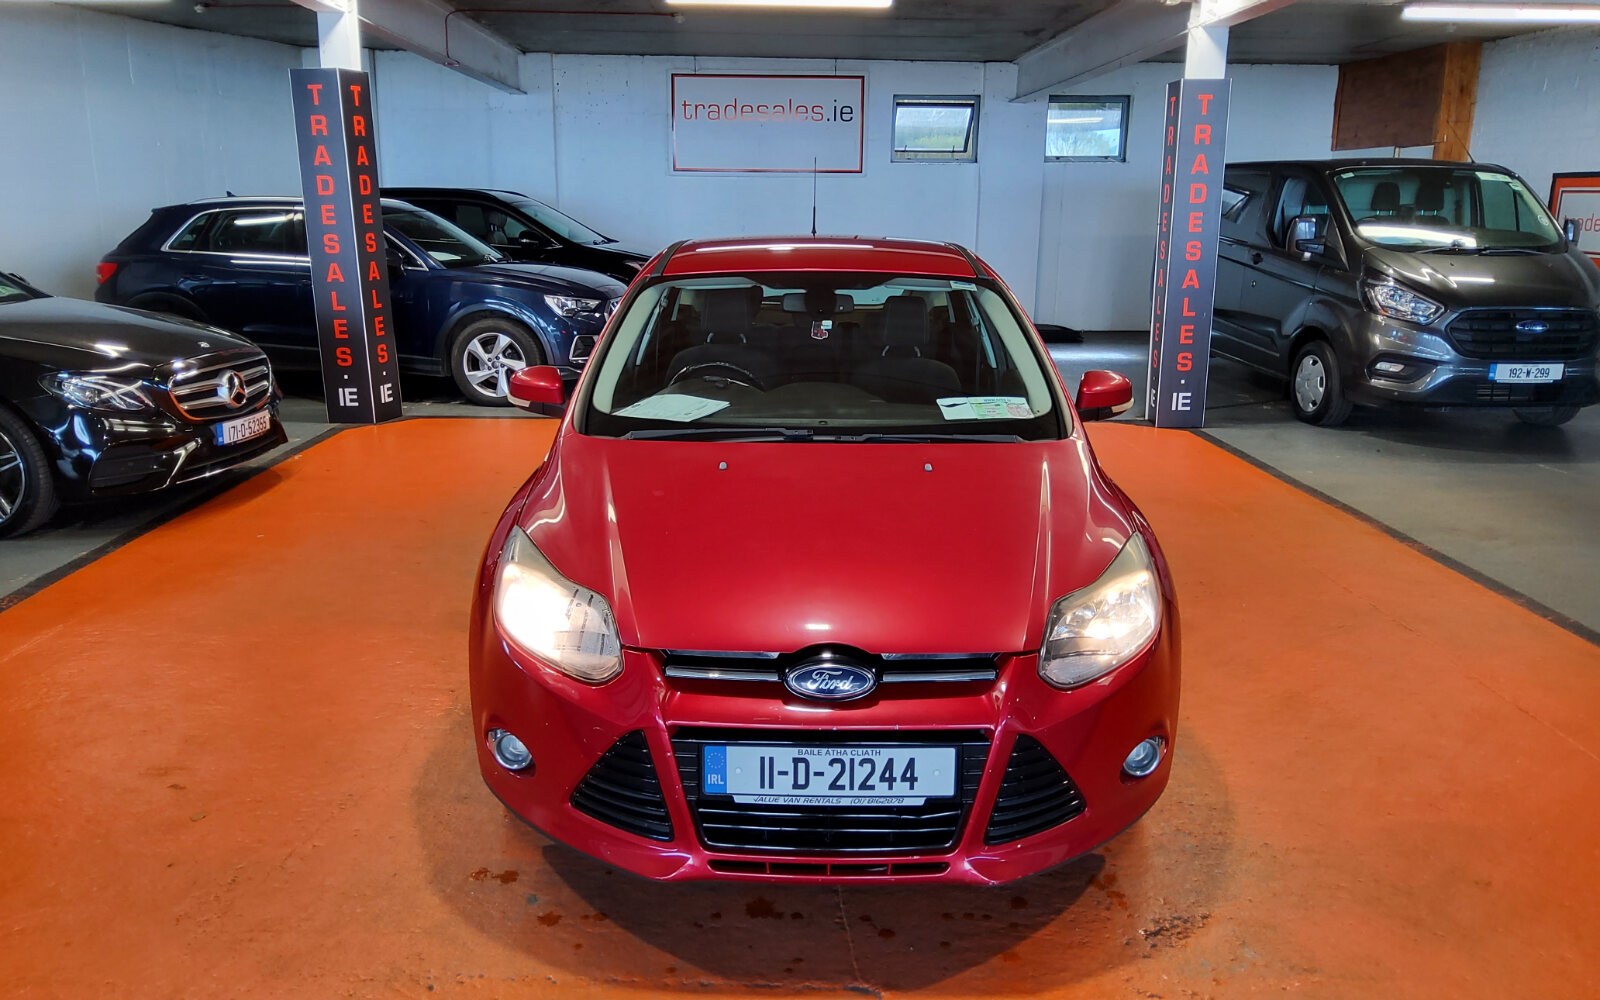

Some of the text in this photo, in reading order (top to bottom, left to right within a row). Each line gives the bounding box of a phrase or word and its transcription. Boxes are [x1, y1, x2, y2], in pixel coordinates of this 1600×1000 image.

[681, 97, 854, 122] tradesales.ie
[1508, 367, 1551, 379] 192-W-299
[806, 669, 854, 690] Ford
[797, 748, 823, 757] BAILE
[850, 749, 881, 757] CLIATH
[707, 774, 725, 785] IRL
[759, 756, 919, 791] 11-D-21244
